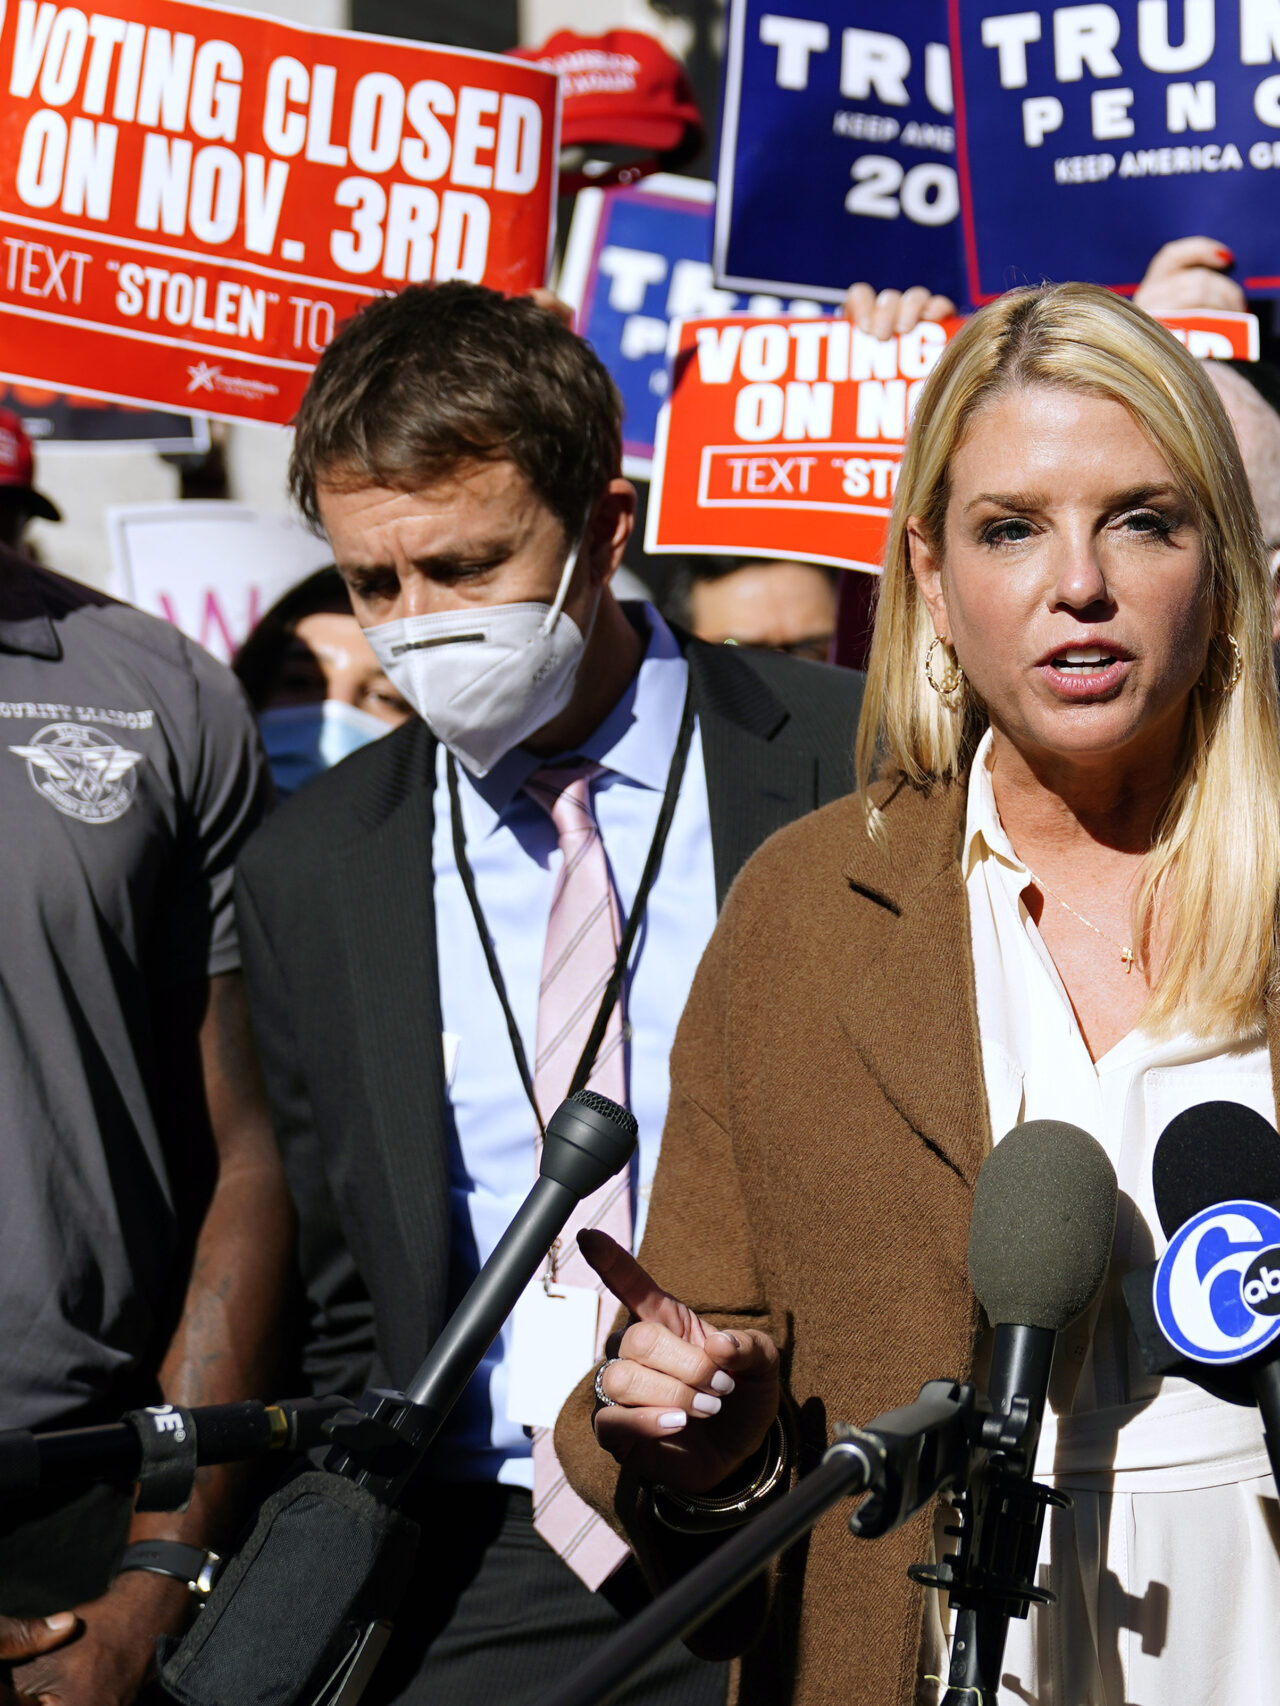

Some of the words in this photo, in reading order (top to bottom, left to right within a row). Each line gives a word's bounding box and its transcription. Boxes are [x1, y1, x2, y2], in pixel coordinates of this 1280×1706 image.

[10, 0, 244, 143] VOTING
[263, 56, 542, 195] CLOSED
[832, 110, 900, 143] KEEP
[16, 109, 118, 221] ON
[136, 132, 304, 262] NOV.
[330, 176, 490, 284] 3RD
[845, 154, 960, 226] 20
[1054, 153, 1116, 184] KEEP
[1118, 143, 1244, 178] AMERICA
[3, 236, 92, 304] TEXT
[289, 297, 335, 352] TO
[696, 321, 947, 384] VOTING
[734, 381, 834, 442] ON
[726, 457, 817, 494] TEXT
[1168, 1213, 1278, 1353] 6
